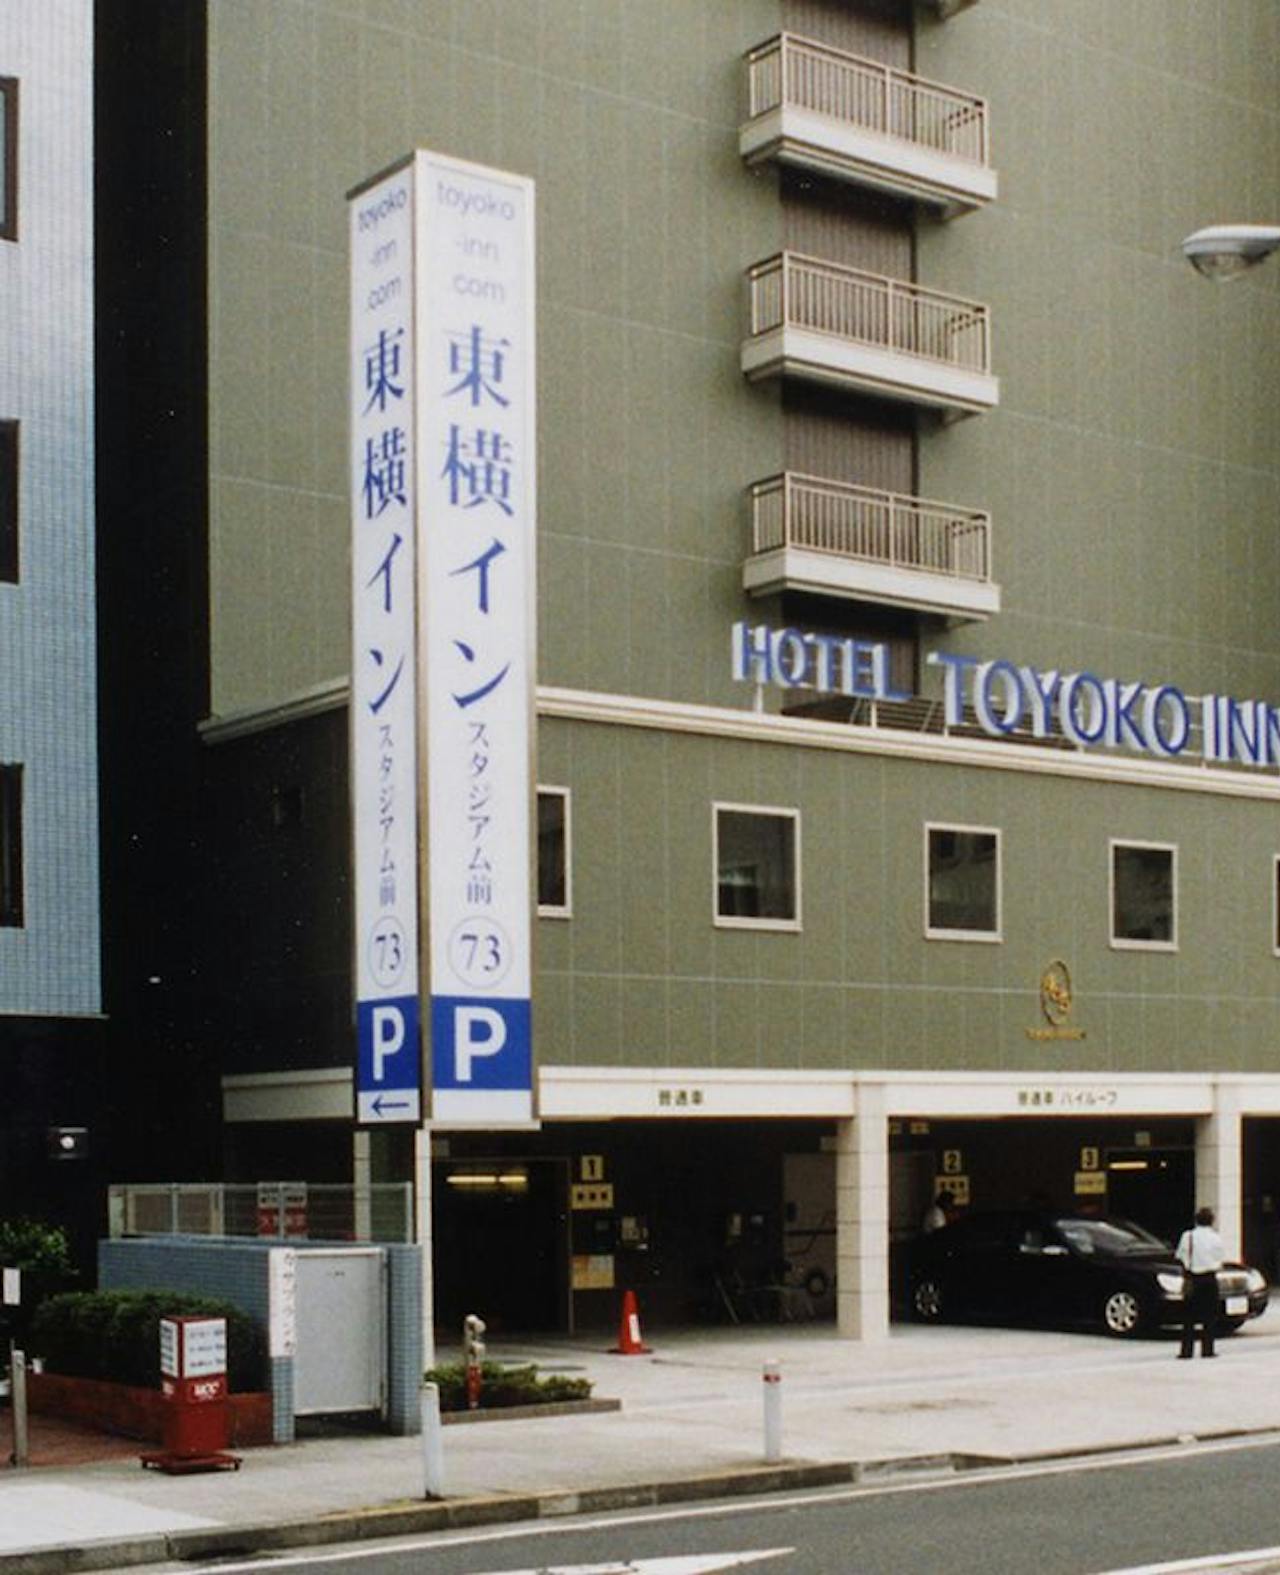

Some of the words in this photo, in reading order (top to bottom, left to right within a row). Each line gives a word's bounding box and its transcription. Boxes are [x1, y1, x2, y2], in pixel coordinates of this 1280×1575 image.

[363, 327, 407, 716] 東横イン
[440, 325, 514, 709] 東横イン
[732, 621, 912, 700] HOTEL
[927, 651, 1192, 757] TOYOKO
[466, 722, 492, 905] スタジアム前
[375, 932, 401, 973] 73
[459, 933, 501, 973] 73
[371, 1006, 405, 1081] P
[455, 1006, 507, 1082] P
